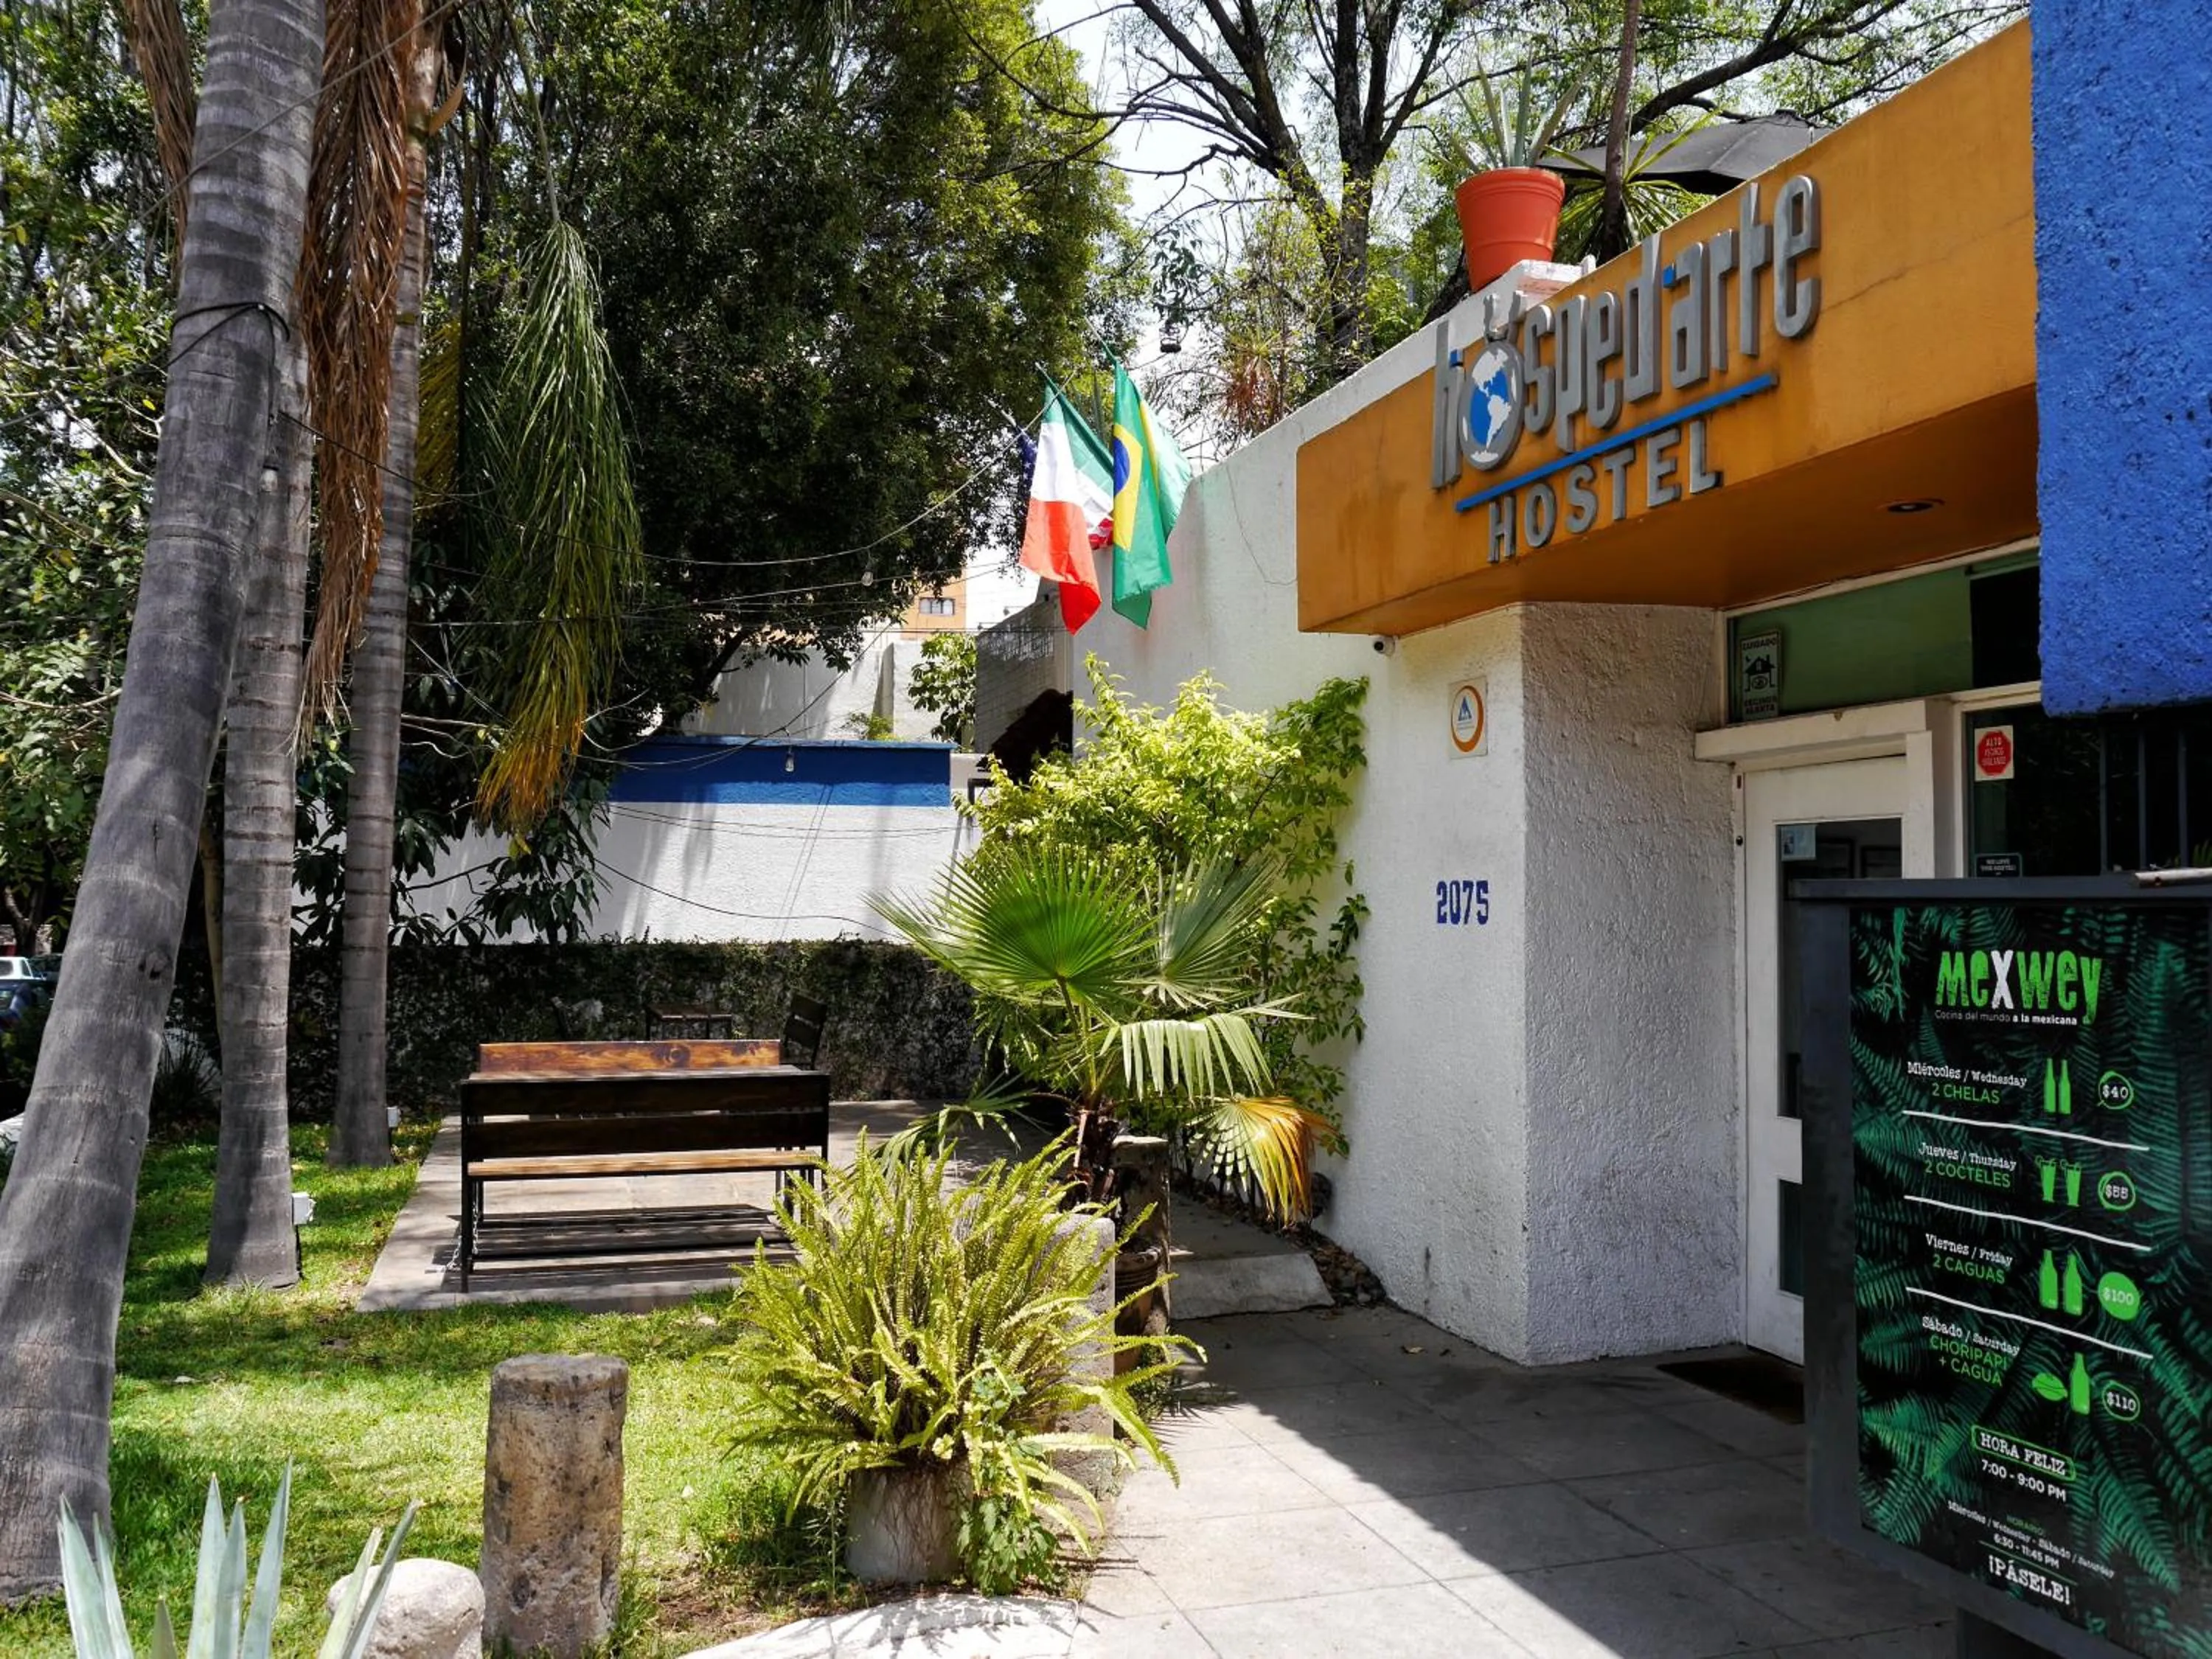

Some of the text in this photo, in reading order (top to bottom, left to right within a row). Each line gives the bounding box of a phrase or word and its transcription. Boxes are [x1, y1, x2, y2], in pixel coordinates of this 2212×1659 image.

[1487, 421, 1723, 563] HOSTEL
[1436, 880, 1489, 925] 2075
[1935, 1009, 1963, 1020] Cocina
[1965, 1011, 1978, 1020] del
[2021, 1014, 2030, 1023] la
[2032, 1015, 2078, 1026] mexicana
[1932, 1082, 2000, 1105] 2 CHELAS
[1971, 1070, 2028, 1089] Wednesday
[2102, 1084, 2129, 1099] $40
[1919, 1141, 1959, 1161] Jueves
[1968, 1152, 2017, 1172] Thursday
[1924, 1159, 2011, 1188] 2 COCTELES
[1925, 1232, 1969, 1256] Viernes
[1933, 1253, 2005, 1285] 2 CAGUAS
[2104, 1287, 2135, 1306] $100
[1930, 1335, 2008, 1371] CHORIPAPI
[1972, 1332, 2020, 1357] Saturday
[1950, 1357, 2003, 1388] CAGUA
[2106, 1391, 2136, 1412] $110
[1980, 1431, 2065, 1476] HORA FELIZ
[1981, 1459, 2007, 1479] 7:00
[2017, 1472, 2045, 1494] 9:00
[2048, 1484, 2067, 1502] PM
[2044, 1554, 2059, 1569] PM
[1988, 1554, 2070, 1605] ¡PÁSELE!
